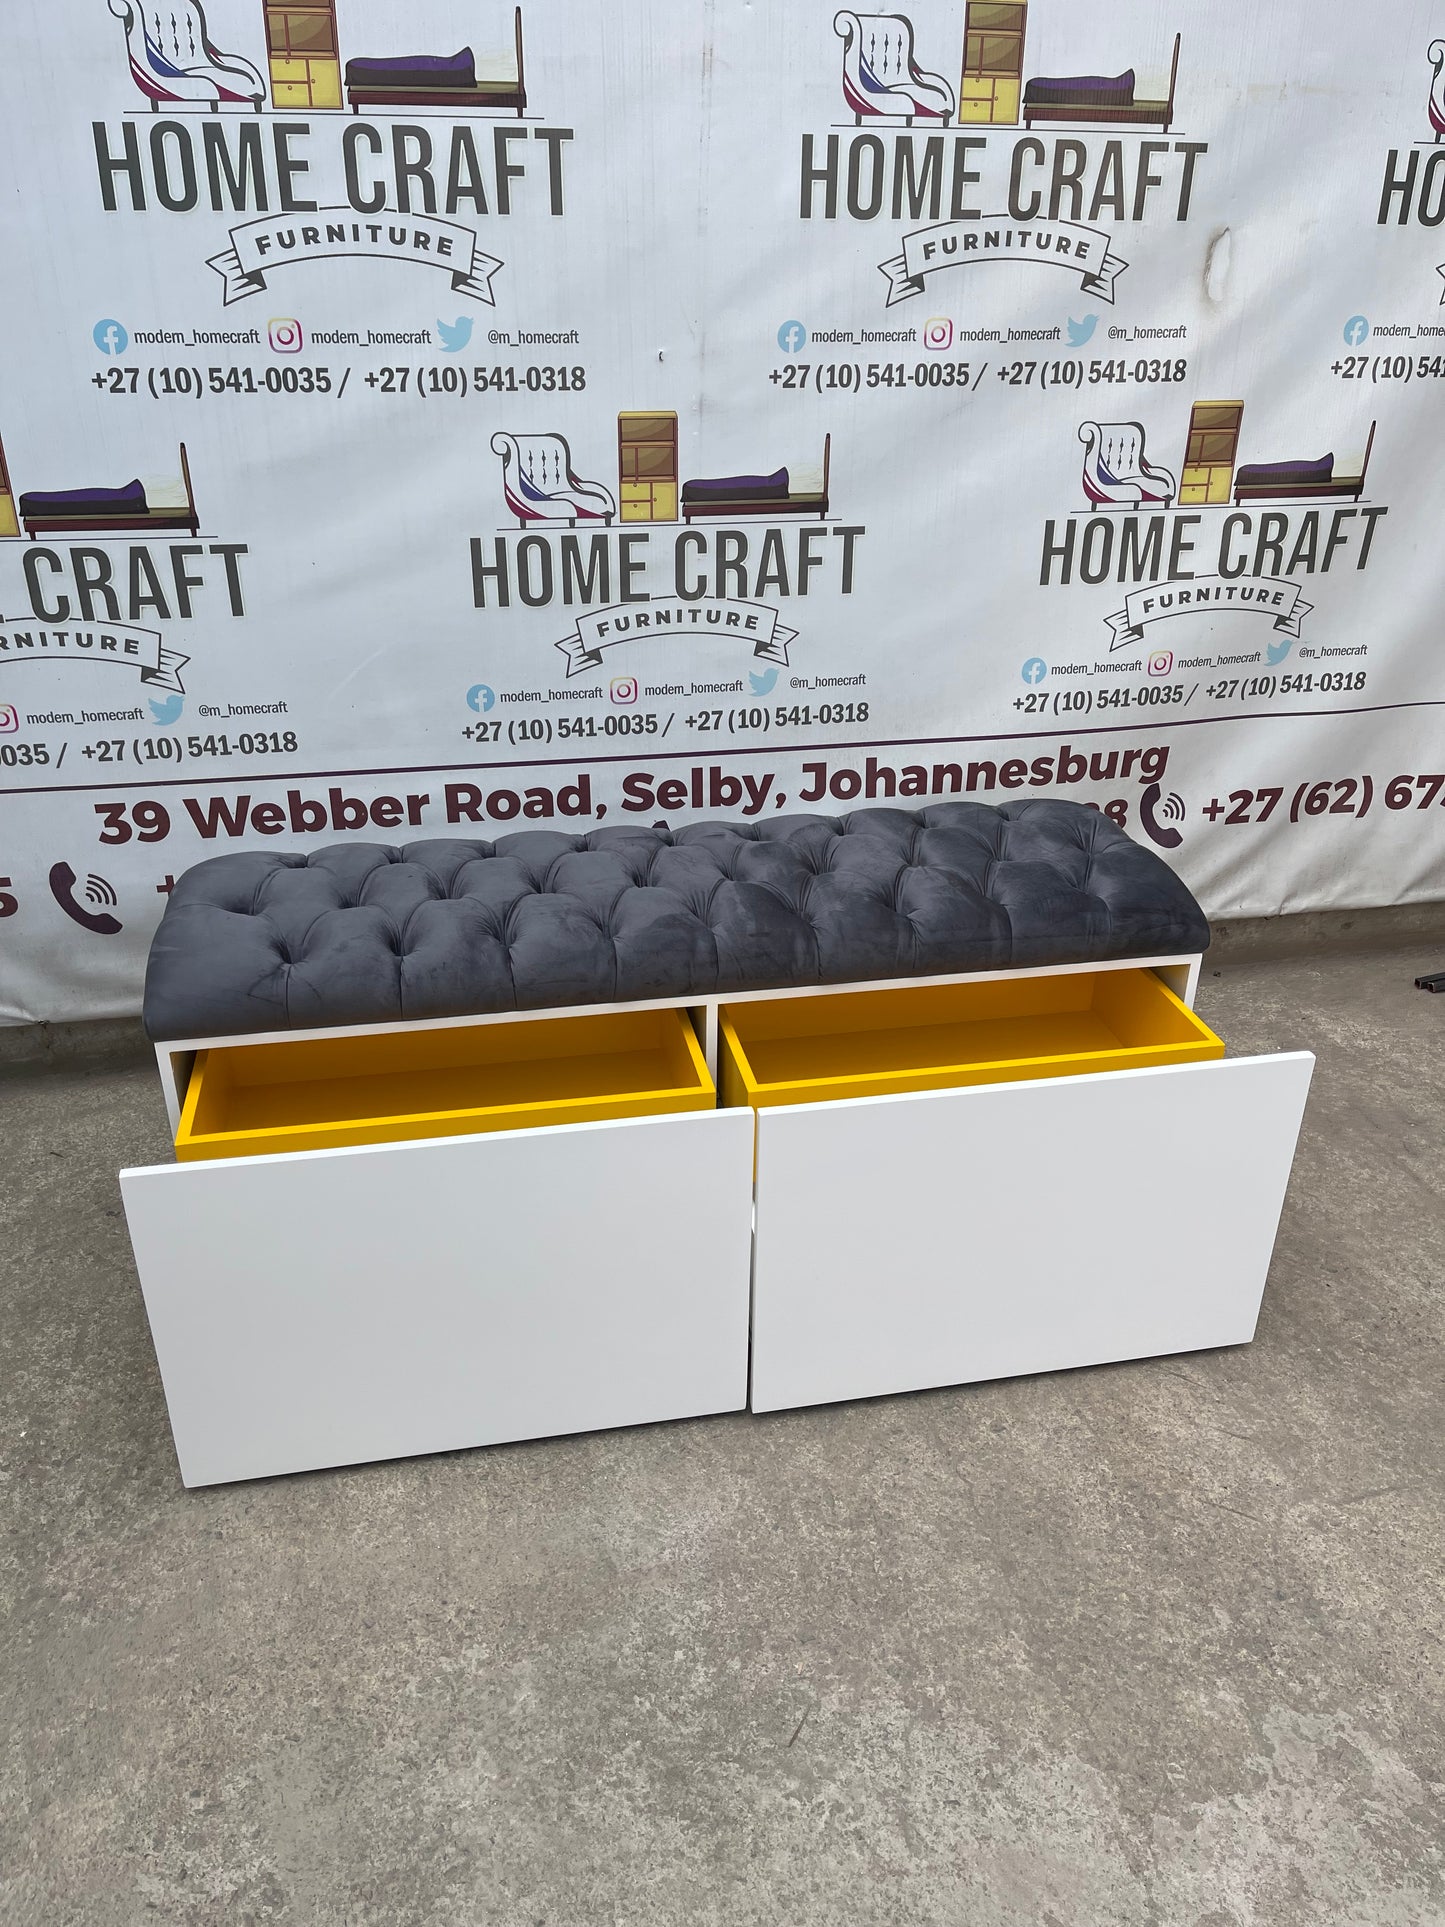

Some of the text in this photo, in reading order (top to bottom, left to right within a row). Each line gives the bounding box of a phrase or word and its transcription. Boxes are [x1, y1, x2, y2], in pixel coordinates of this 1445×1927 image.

[92, 121, 575, 216] HOME CRAFT
[799, 133, 1208, 222] HOME CRAFT
[1376, 148, 1445, 227] HO
[255, 224, 454, 258] FURNITURE
[922, 230, 1092, 260] FURNITURE
[486, 329, 580, 347] @m_homecraft
[1107, 324, 1187, 342] @m_homecraft
[1372, 323, 1445, 339] modern_home
[91, 366, 140, 394] +27
[147, 367, 203, 399] (10)
[208, 366, 332, 394] 541-0035
[364, 366, 410, 393] +27
[417, 367, 468, 398] (10)
[473, 365, 587, 393] 541-0318
[768, 364, 811, 390] +27
[814, 365, 862, 395] (10)
[866, 362, 970, 389] 541-0035
[997, 361, 1037, 386] +27
[1040, 361, 1085, 390] (10)
[1088, 358, 1187, 386] 541-0318
[1330, 356, 1369, 379] +27
[1371, 356, 1413, 384] (10)
[1039, 506, 1389, 586] HOME CRAFT
[22, 543, 249, 623] CRAFT
[469, 525, 866, 609] HOME CRAFT
[1142, 586, 1286, 614] FURNITURE
[596, 608, 759, 638] FURNITURE
[1299, 644, 1369, 660] @m_homecraft
[789, 674, 867, 691] @m_homecraft
[1012, 693, 1050, 714] +27
[1052, 690, 1094, 716] (10)
[1096, 685, 1184, 709] 541-0035
[1205, 679, 1239, 701] +27
[1240, 676, 1277, 700] (10)
[1279, 671, 1367, 695] 541-0318
[198, 701, 288, 719] @m_homecraft
[461, 721, 503, 744] +27
[507, 719, 553, 746] (10)
[557, 714, 659, 739] 541-0035
[684, 710, 724, 734] +27
[728, 708, 774, 734] (10)
[774, 702, 870, 727] 541-0318
[0, 742, 51, 767] 035
[81, 740, 126, 762] +27
[132, 737, 184, 764] (10)
[187, 731, 299, 757] 541-0318
[94, 745, 1171, 845] 39 Webber Road, Selby, Johannesburg
[1202, 774, 1445, 826] +27 (62) 67
